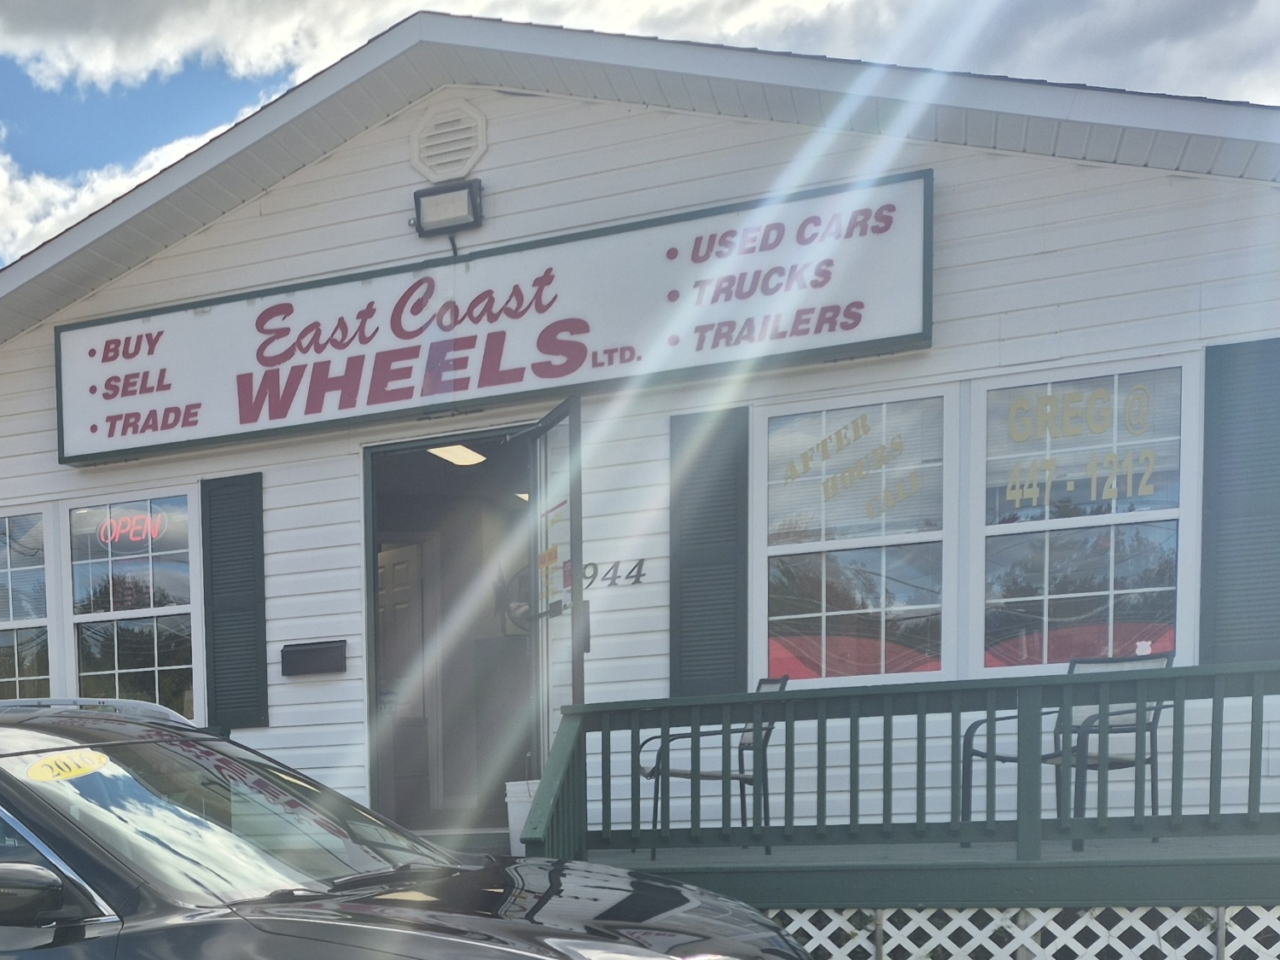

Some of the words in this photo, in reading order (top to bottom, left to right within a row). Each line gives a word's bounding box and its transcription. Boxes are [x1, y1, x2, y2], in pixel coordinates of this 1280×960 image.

[690, 221, 786, 264] USED
[795, 203, 897, 246] CARS
[692, 258, 835, 307] TRUCKS
[255, 301, 380, 368] East
[389, 266, 559, 341] Coast
[693, 300, 866, 352] TRAILERS
[101, 330, 165, 364] BUY
[235, 316, 591, 426] WHEELS
[591, 344, 643, 369] LTD.
[102, 367, 173, 401] SELL
[105, 402, 202, 439] TRADE
[1007, 388, 1113, 444] GREG
[783, 412, 872, 487] AFTER
[821, 432, 905, 503] HOURS
[100, 512, 162, 544] OPEN
[582, 558, 647, 590] 944
[41, 752, 96, 779] 2016
